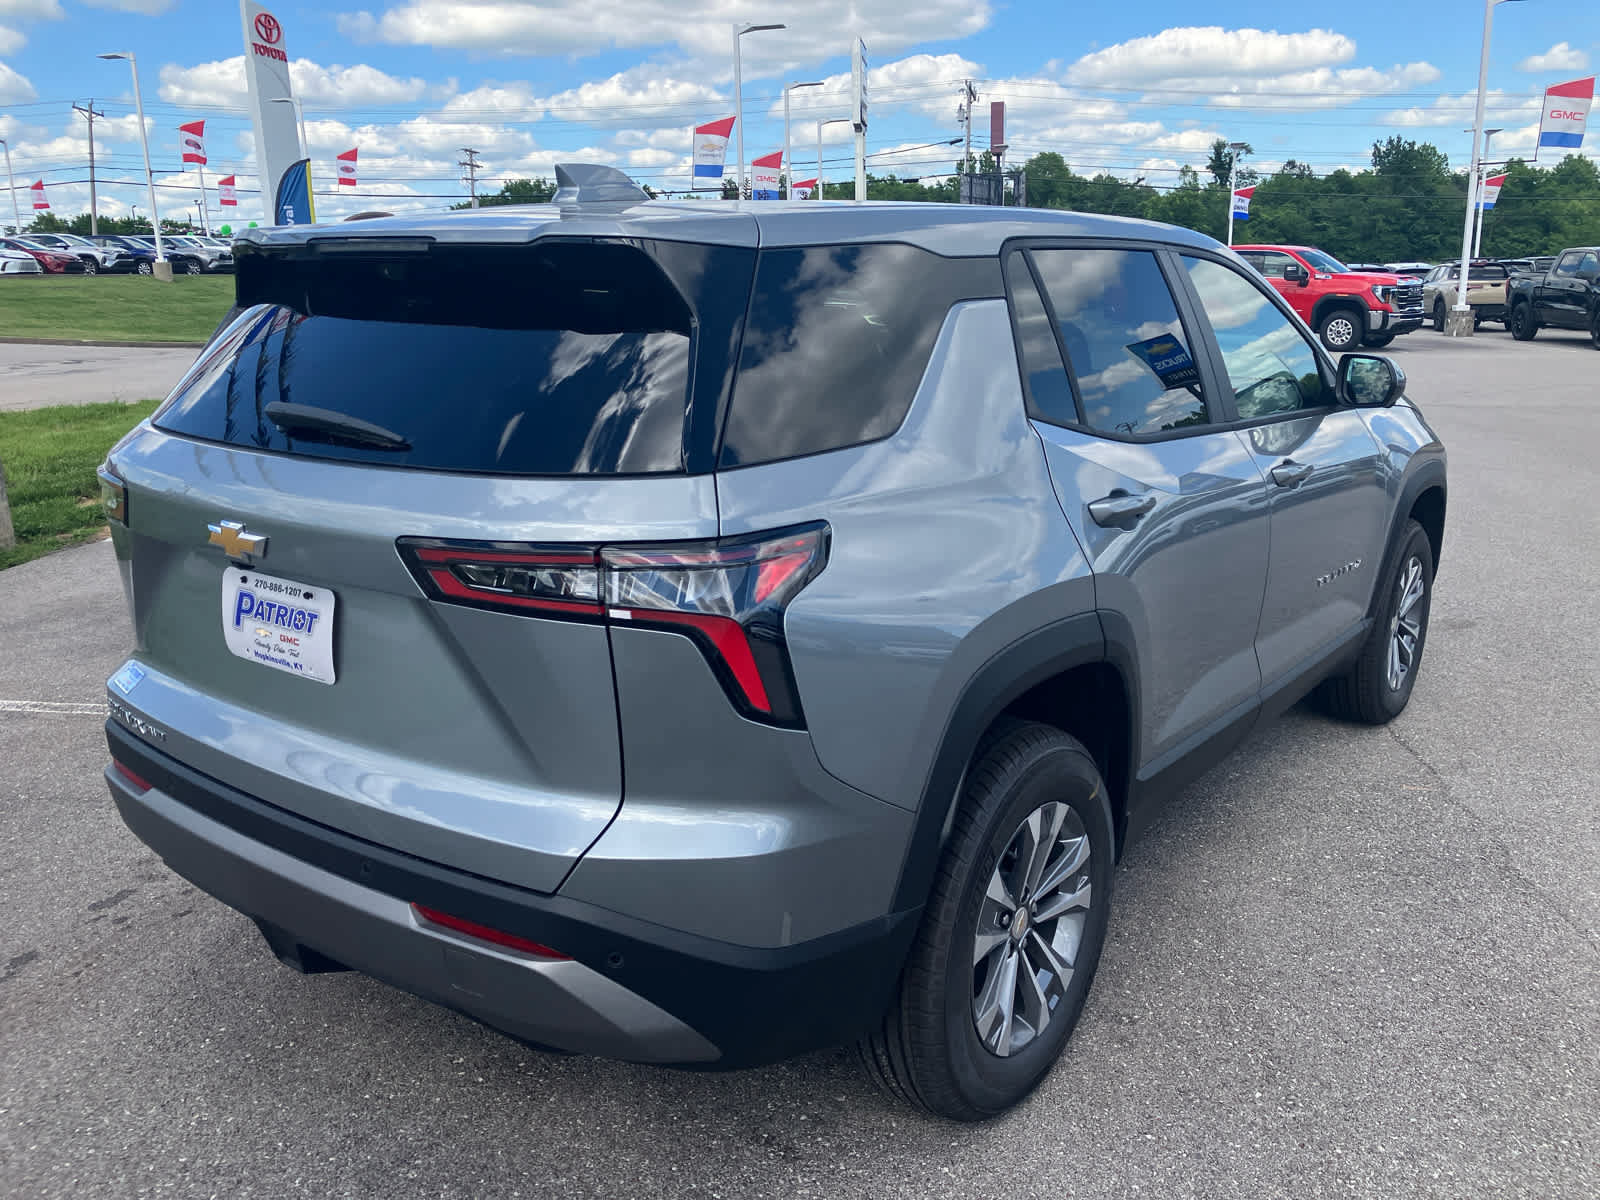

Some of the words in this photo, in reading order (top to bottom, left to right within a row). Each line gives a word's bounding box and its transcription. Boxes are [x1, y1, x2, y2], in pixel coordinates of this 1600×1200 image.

[252, 42, 288, 63] TOYOTA
[1549, 110, 1585, 121] GMC
[756, 175, 777, 183] GMC
[254, 579, 302, 598] 270-886-1207
[234, 589, 319, 634] PATRIOT
[279, 633, 300, 646] GMC
[293, 662, 304, 672] KY
